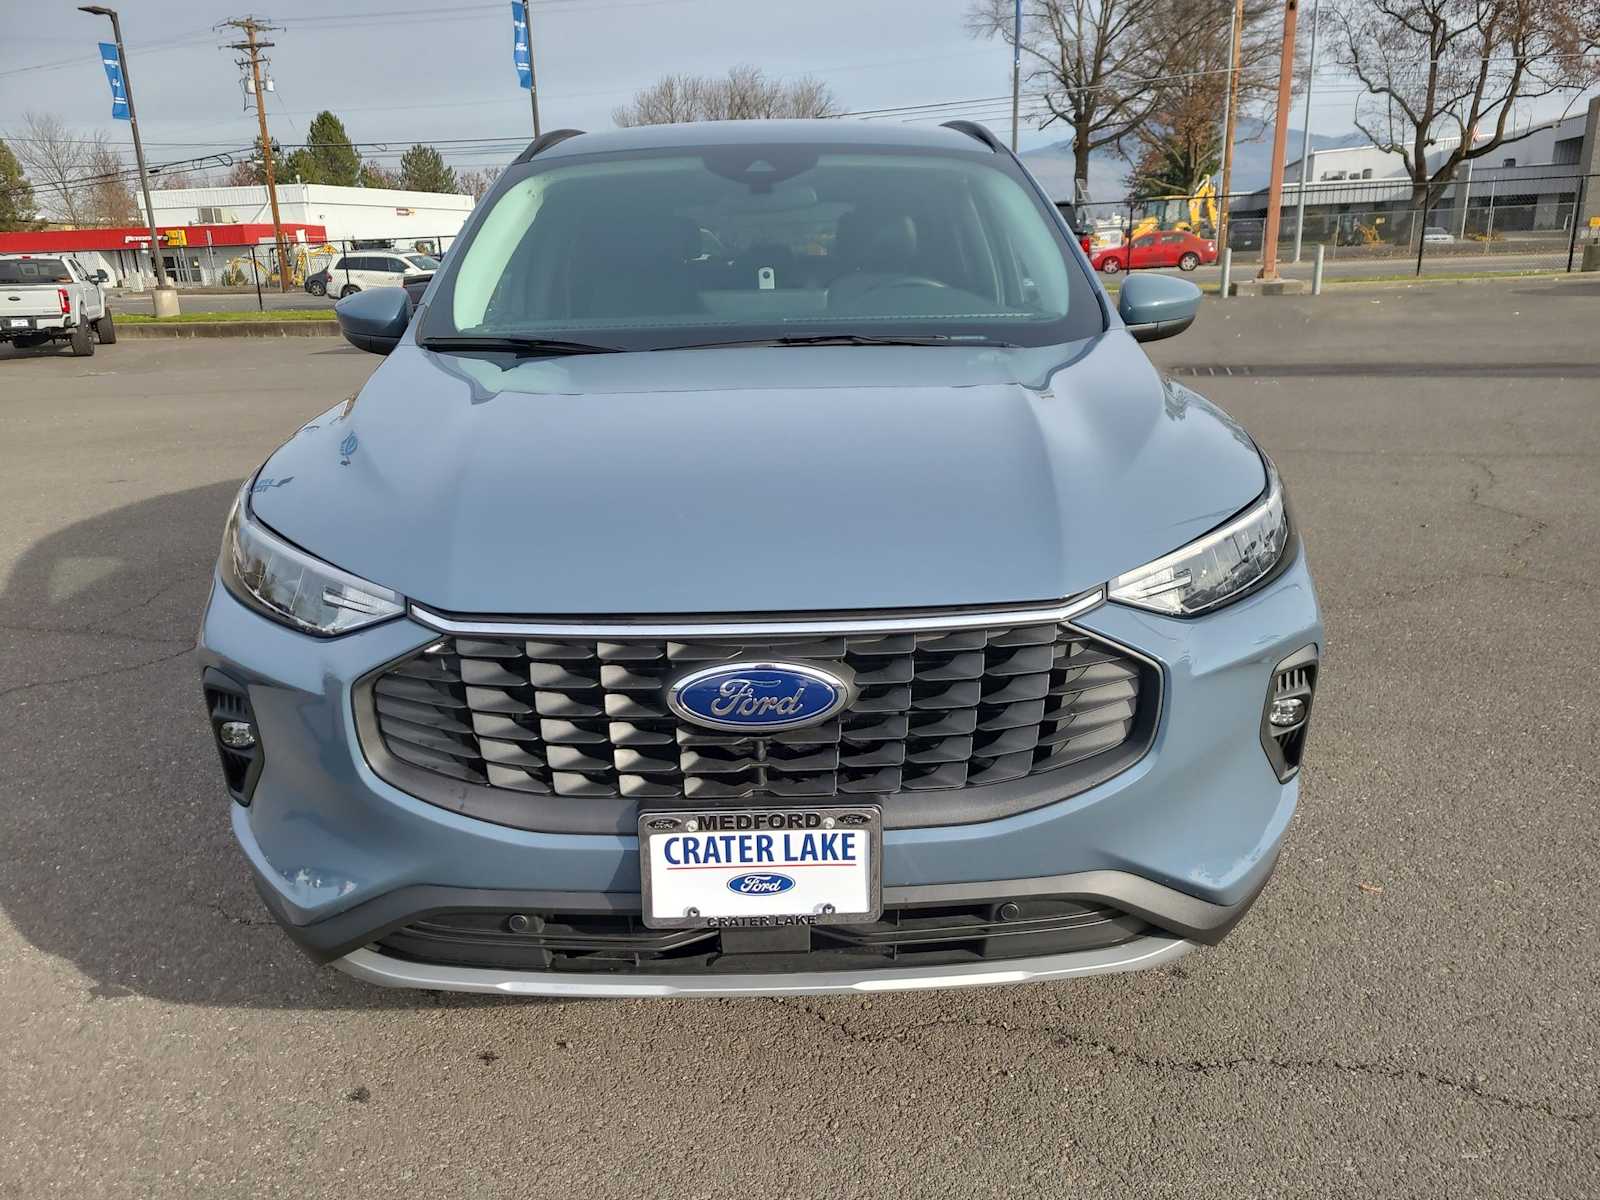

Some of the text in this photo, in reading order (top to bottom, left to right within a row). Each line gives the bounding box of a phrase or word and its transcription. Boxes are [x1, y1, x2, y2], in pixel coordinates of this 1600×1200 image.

[711, 678, 805, 716] Ford
[697, 813, 821, 831] MEDFORD
[664, 833, 857, 865] CRATER LAKE
[740, 875, 782, 892] Ford
[706, 914, 817, 927] CRATER LAKE
